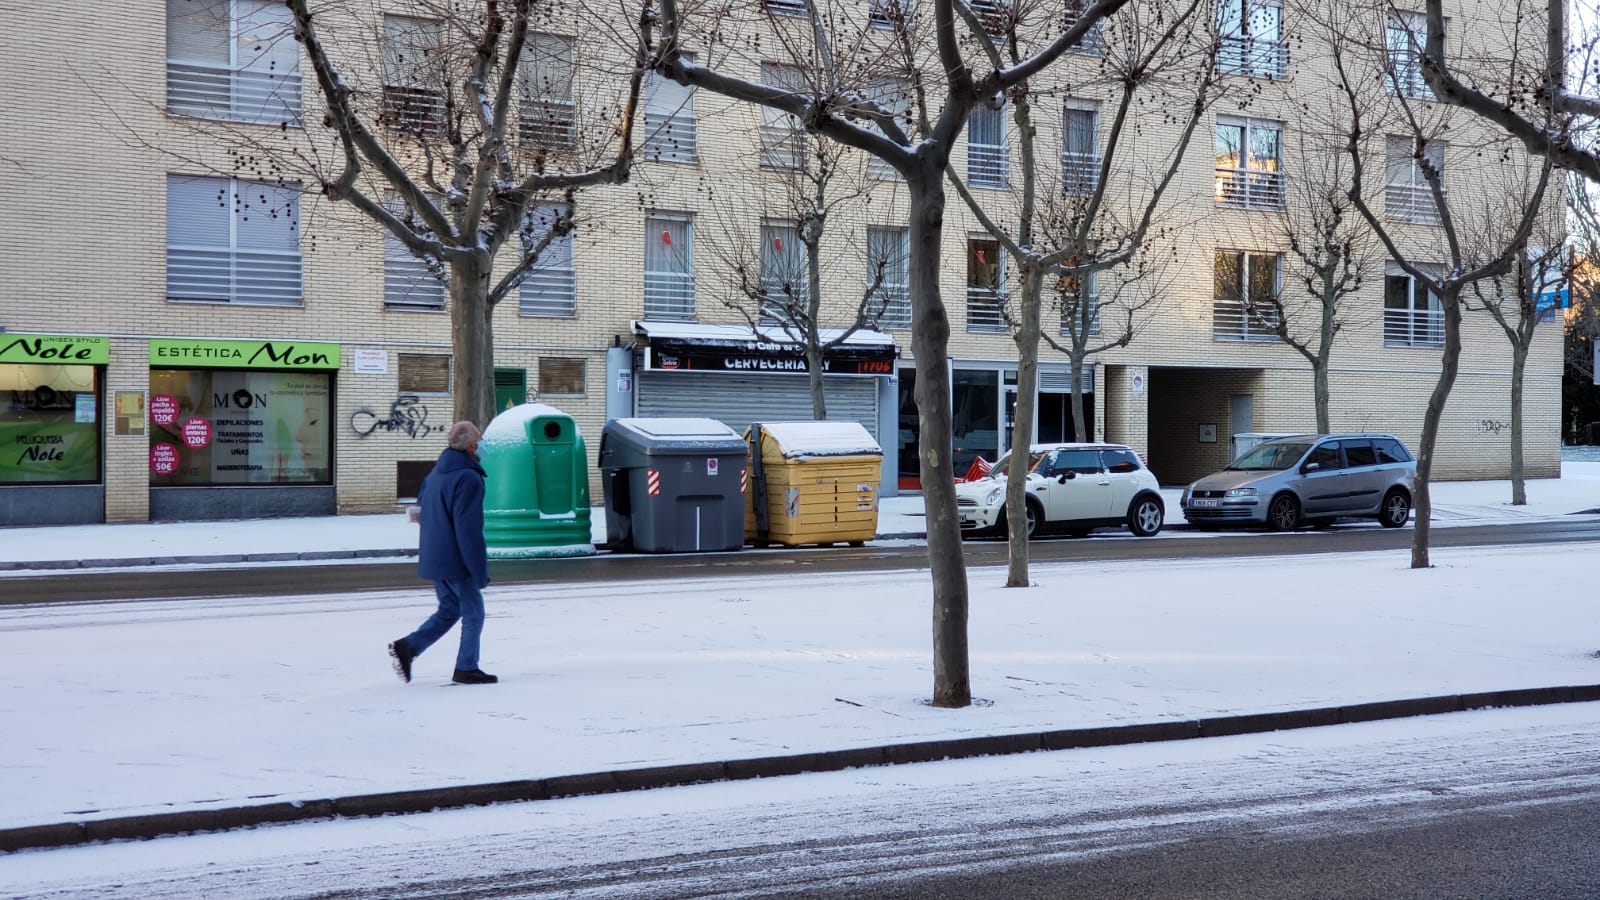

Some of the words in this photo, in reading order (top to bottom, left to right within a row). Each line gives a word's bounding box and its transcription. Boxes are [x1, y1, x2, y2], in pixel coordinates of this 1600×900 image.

[0, 338, 92, 360] Nole
[158, 345, 242, 359] ESTÉTICA
[247, 342, 330, 365] Mon
[213, 389, 267, 409] MON
[153, 414, 173, 422] 120€
[187, 436, 206, 444] 120€
[16, 445, 65, 466] Nole
[155, 463, 173, 471] 50€
